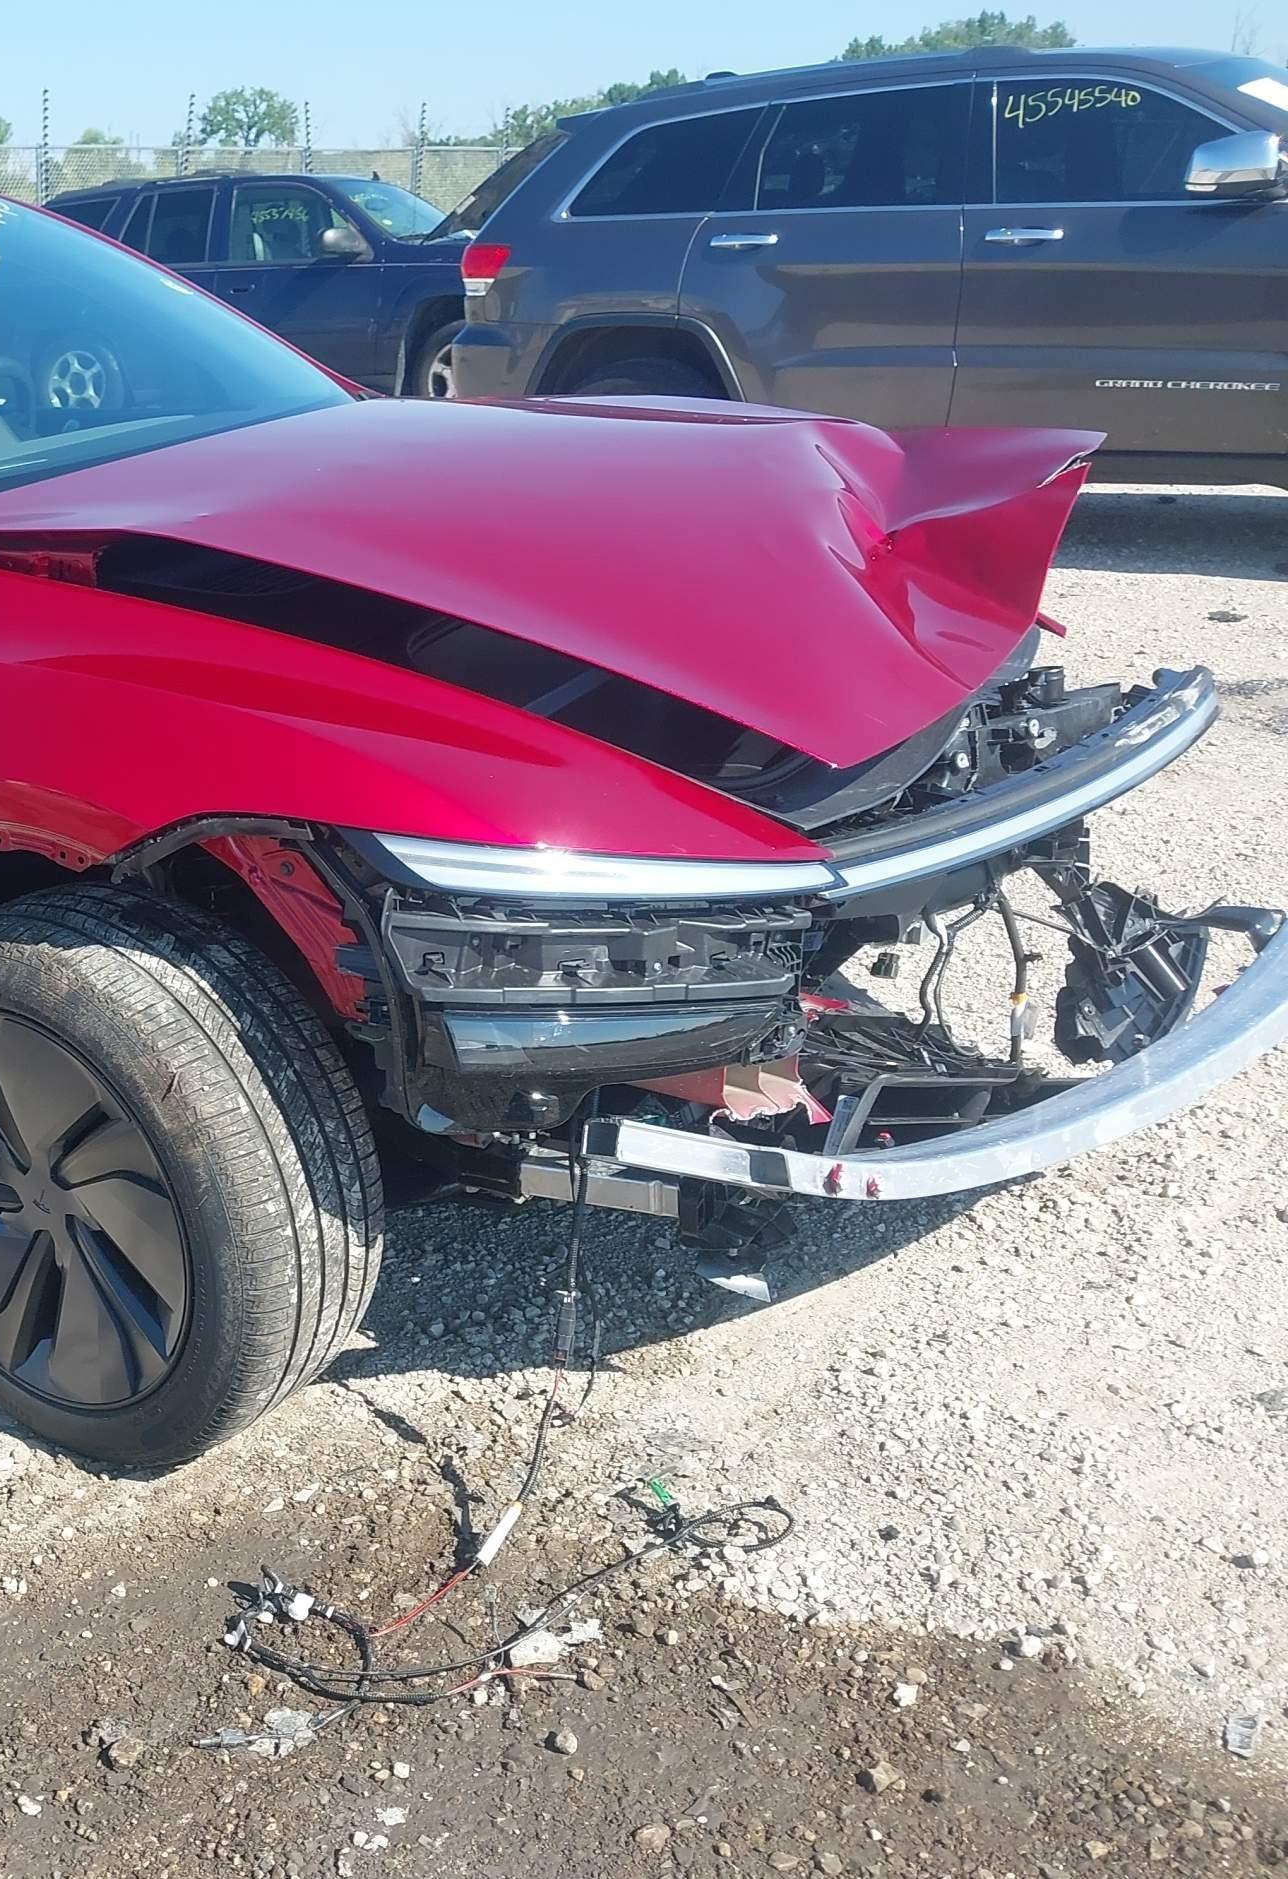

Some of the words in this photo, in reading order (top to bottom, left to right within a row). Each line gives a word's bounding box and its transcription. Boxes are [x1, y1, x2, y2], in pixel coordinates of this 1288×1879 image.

[1004, 85, 1142, 128] 45545540
[1095, 379, 1163, 388] GRAND
[1166, 380, 1281, 391] CHEROKEE
